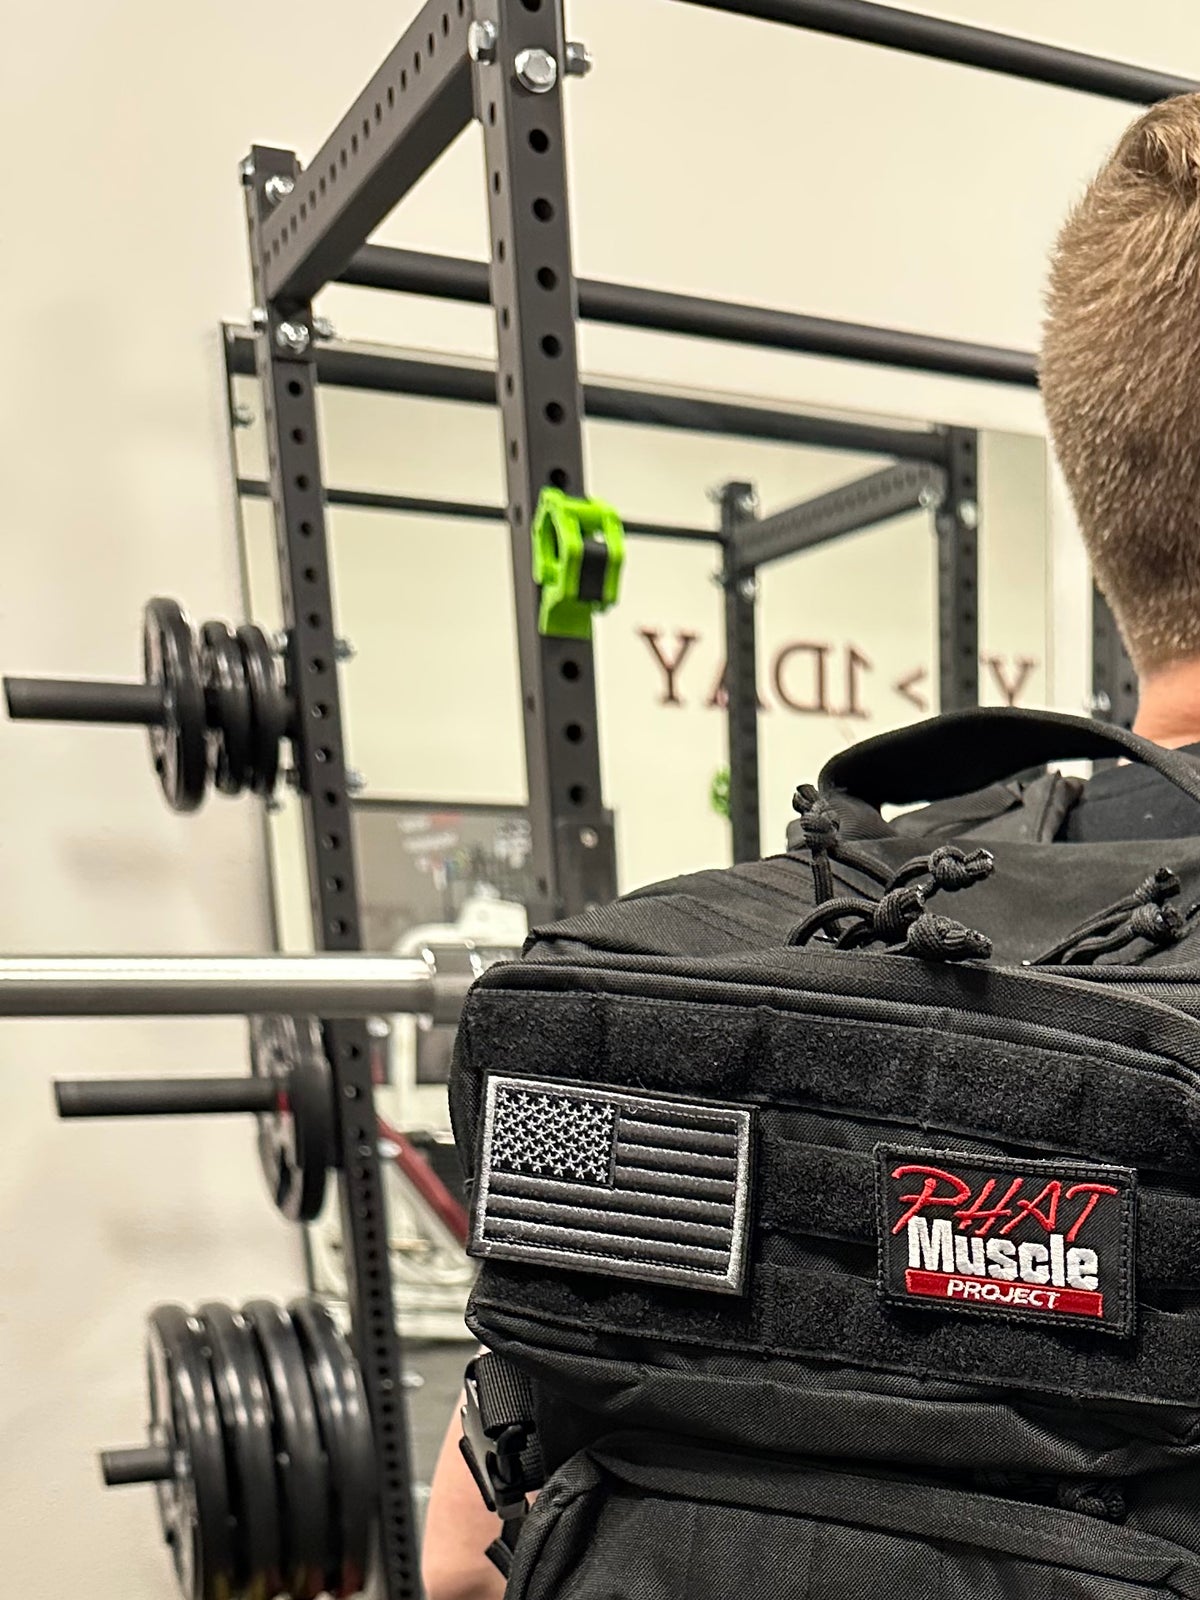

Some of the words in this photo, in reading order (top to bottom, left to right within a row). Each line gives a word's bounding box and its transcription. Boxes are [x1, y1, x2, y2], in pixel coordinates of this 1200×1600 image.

[891, 1165, 1118, 1241] PHAT
[907, 1215, 1099, 1291] Muscle
[947, 1279, 1061, 1310] PROJECT
